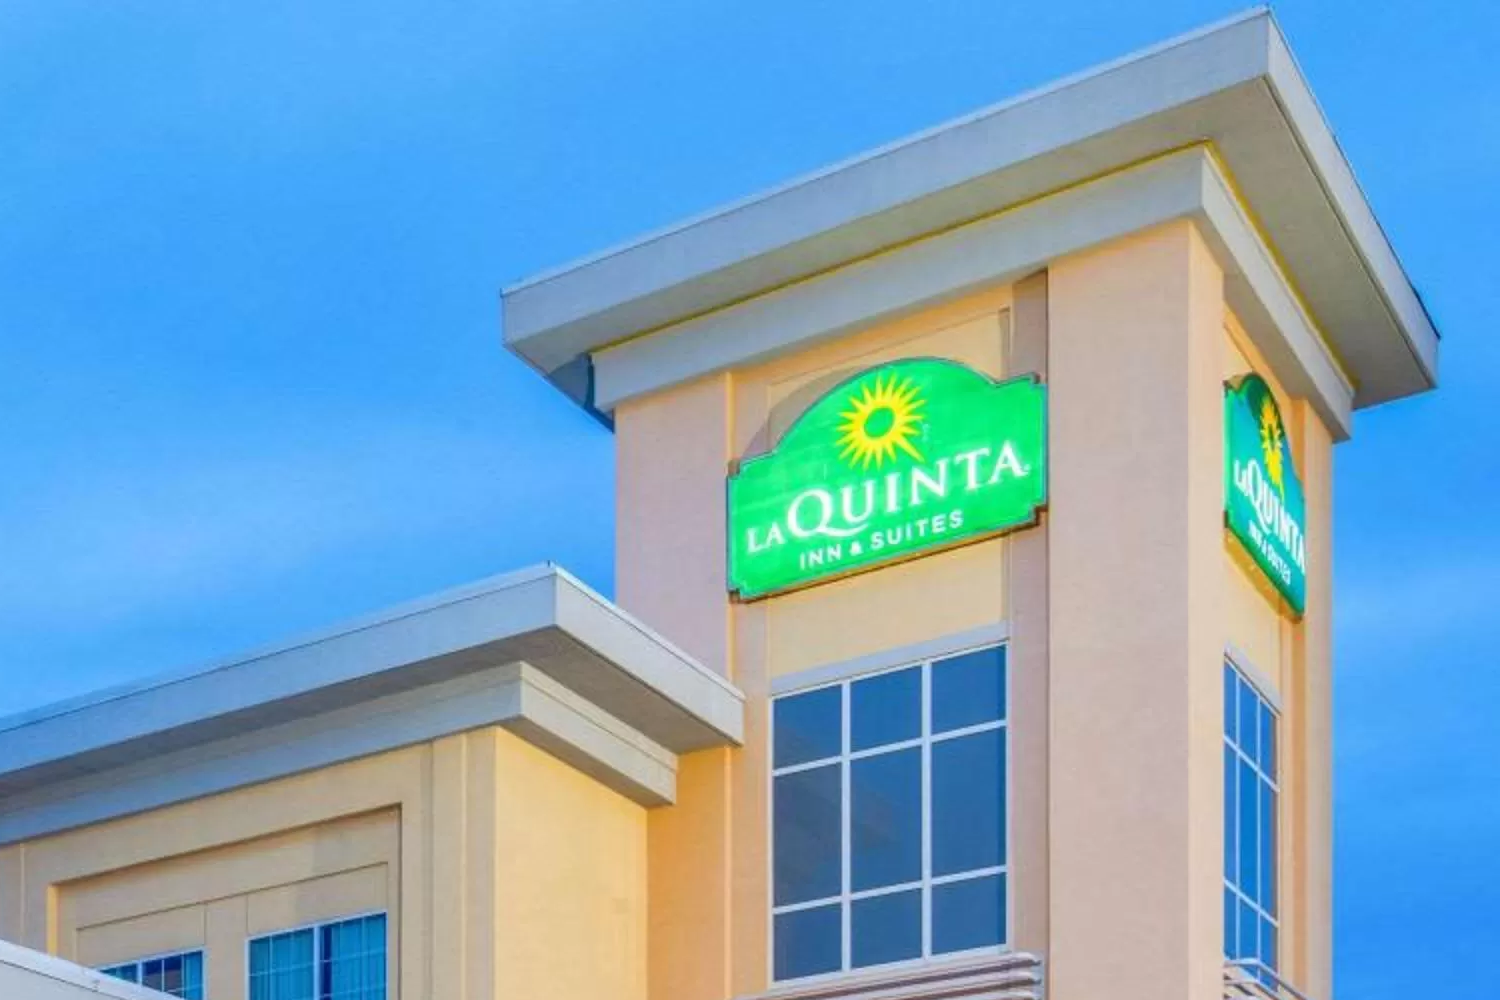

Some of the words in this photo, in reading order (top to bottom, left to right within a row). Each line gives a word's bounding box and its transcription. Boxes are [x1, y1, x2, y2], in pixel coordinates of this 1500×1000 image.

[747, 521, 785, 554] LA
[787, 440, 1027, 537] QUINTA
[800, 543, 841, 570] INN
[870, 510, 963, 550] SUITES
